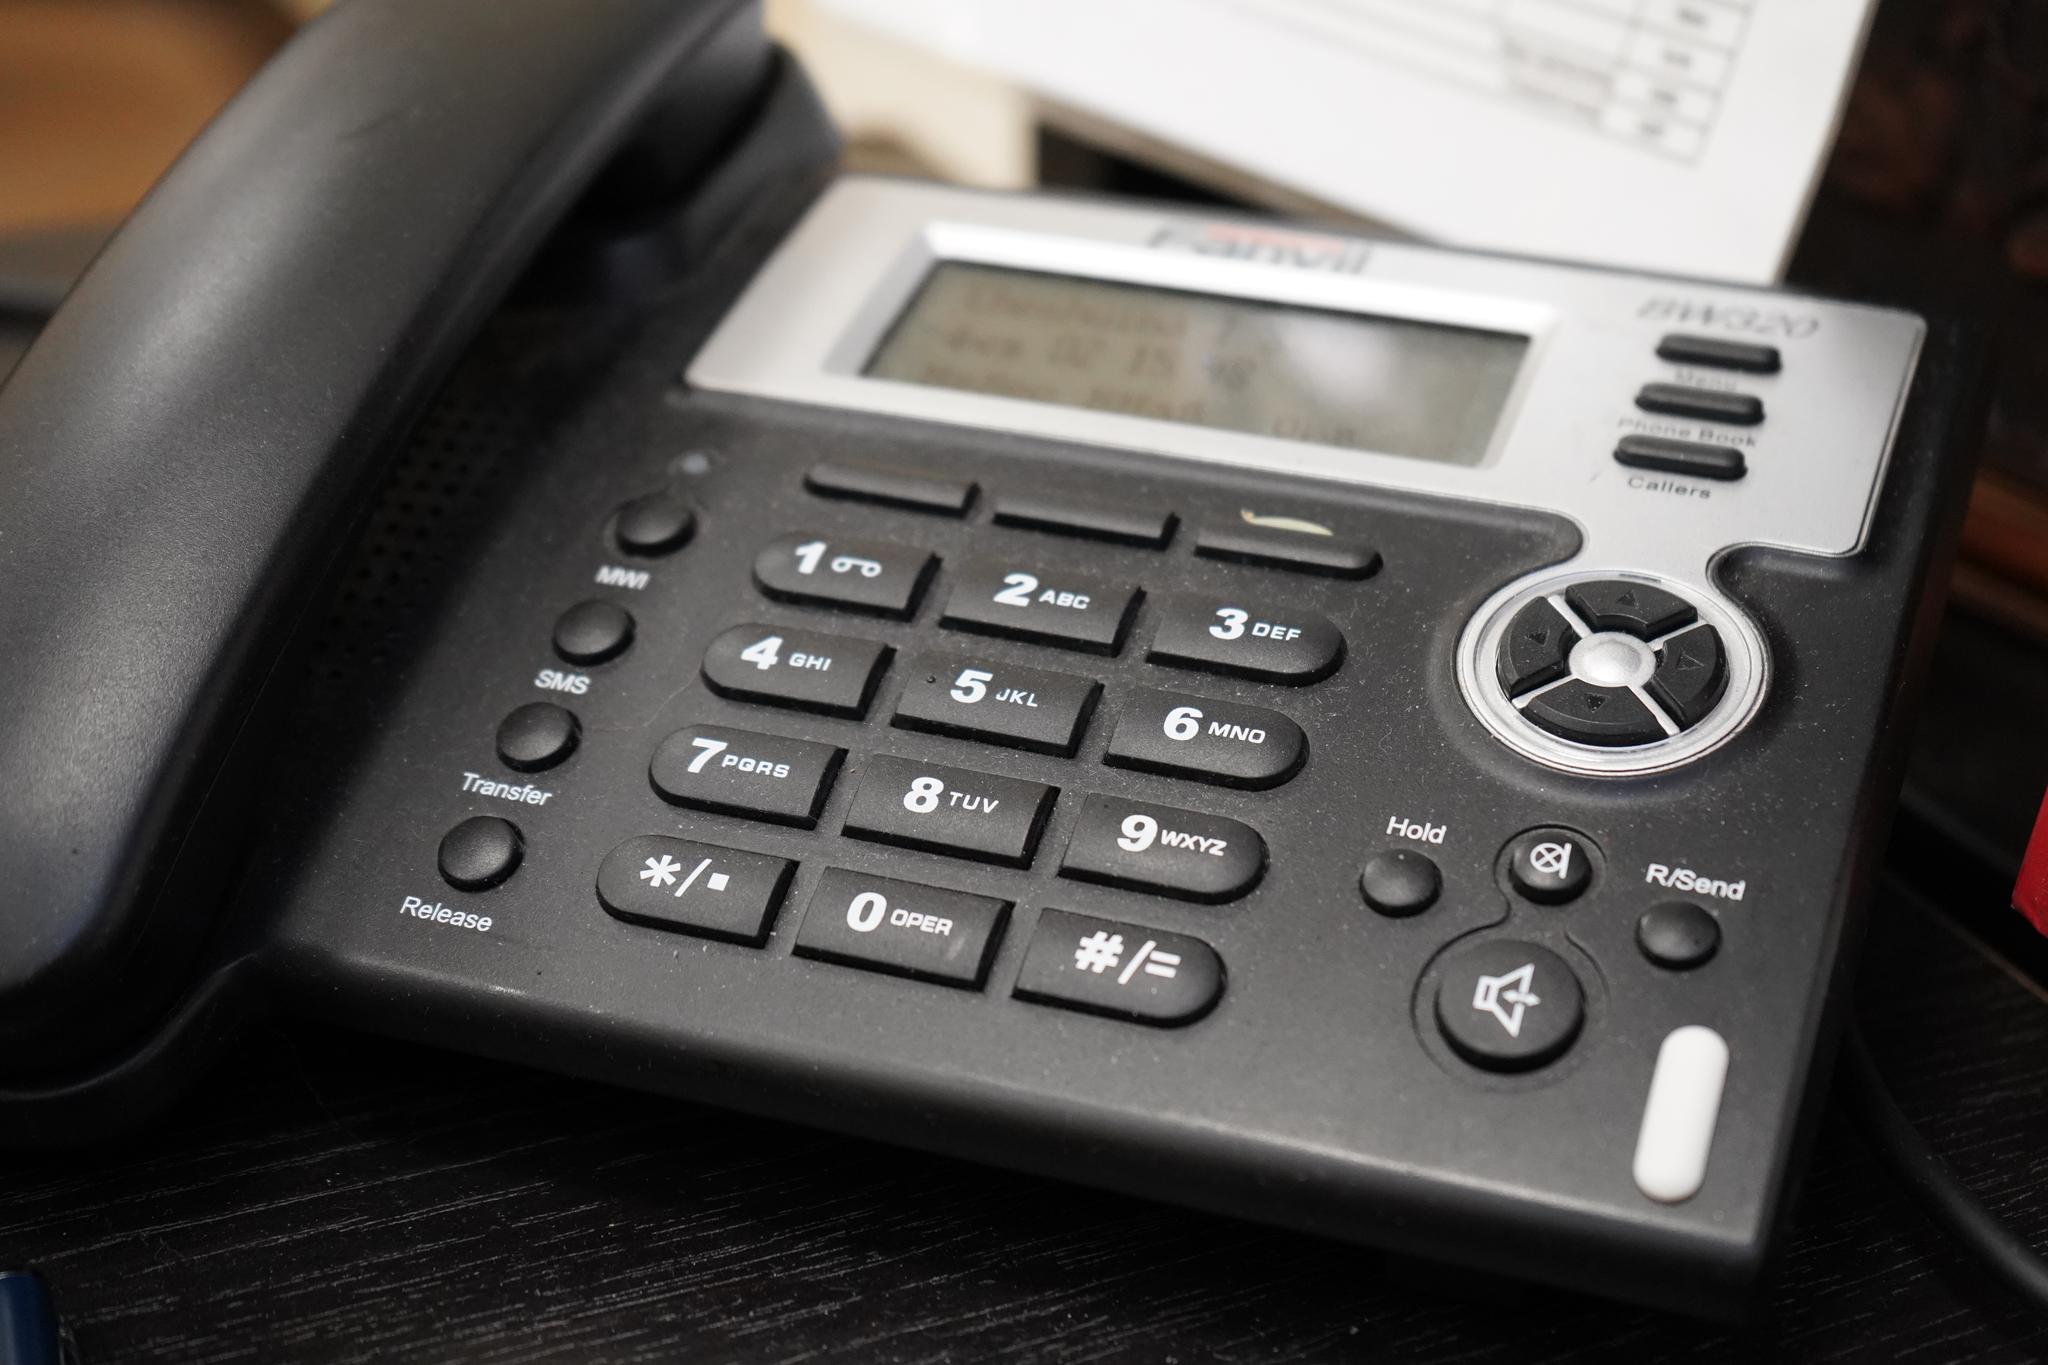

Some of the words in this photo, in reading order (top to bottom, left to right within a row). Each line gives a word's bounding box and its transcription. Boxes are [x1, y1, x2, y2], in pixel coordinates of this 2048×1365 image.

[1617, 416, 1691, 438] Phone
[1699, 427, 1757, 448] Book
[1627, 476, 1711, 499] Callers
[796, 541, 827, 575] 1
[595, 565, 649, 590] MWI
[993, 573, 1038, 607] 2
[1039, 589, 1090, 609] ABC
[1209, 608, 1248, 640] 3
[1251, 622, 1301, 641] DEF
[741, 636, 783, 670] 4
[789, 653, 832, 671] GHI
[534, 668, 591, 694] SMS
[950, 669, 993, 703] 5
[995, 688, 1038, 707] JKL
[1163, 707, 1203, 741] 6
[1208, 721, 1266, 744] MNO
[687, 738, 728, 774] 7
[721, 755, 790, 779] PQRS
[461, 772, 552, 806] Transfer
[903, 776, 944, 813] 8
[949, 791, 999, 814] TUV
[1117, 814, 1158, 852] 9
[1160, 828, 1228, 857] WXYZ
[1386, 816, 1447, 844] Hold
[1646, 863, 1746, 901] R/Send
[400, 895, 493, 932] Release
[846, 892, 887, 932] 0
[890, 908, 953, 936] OPER
